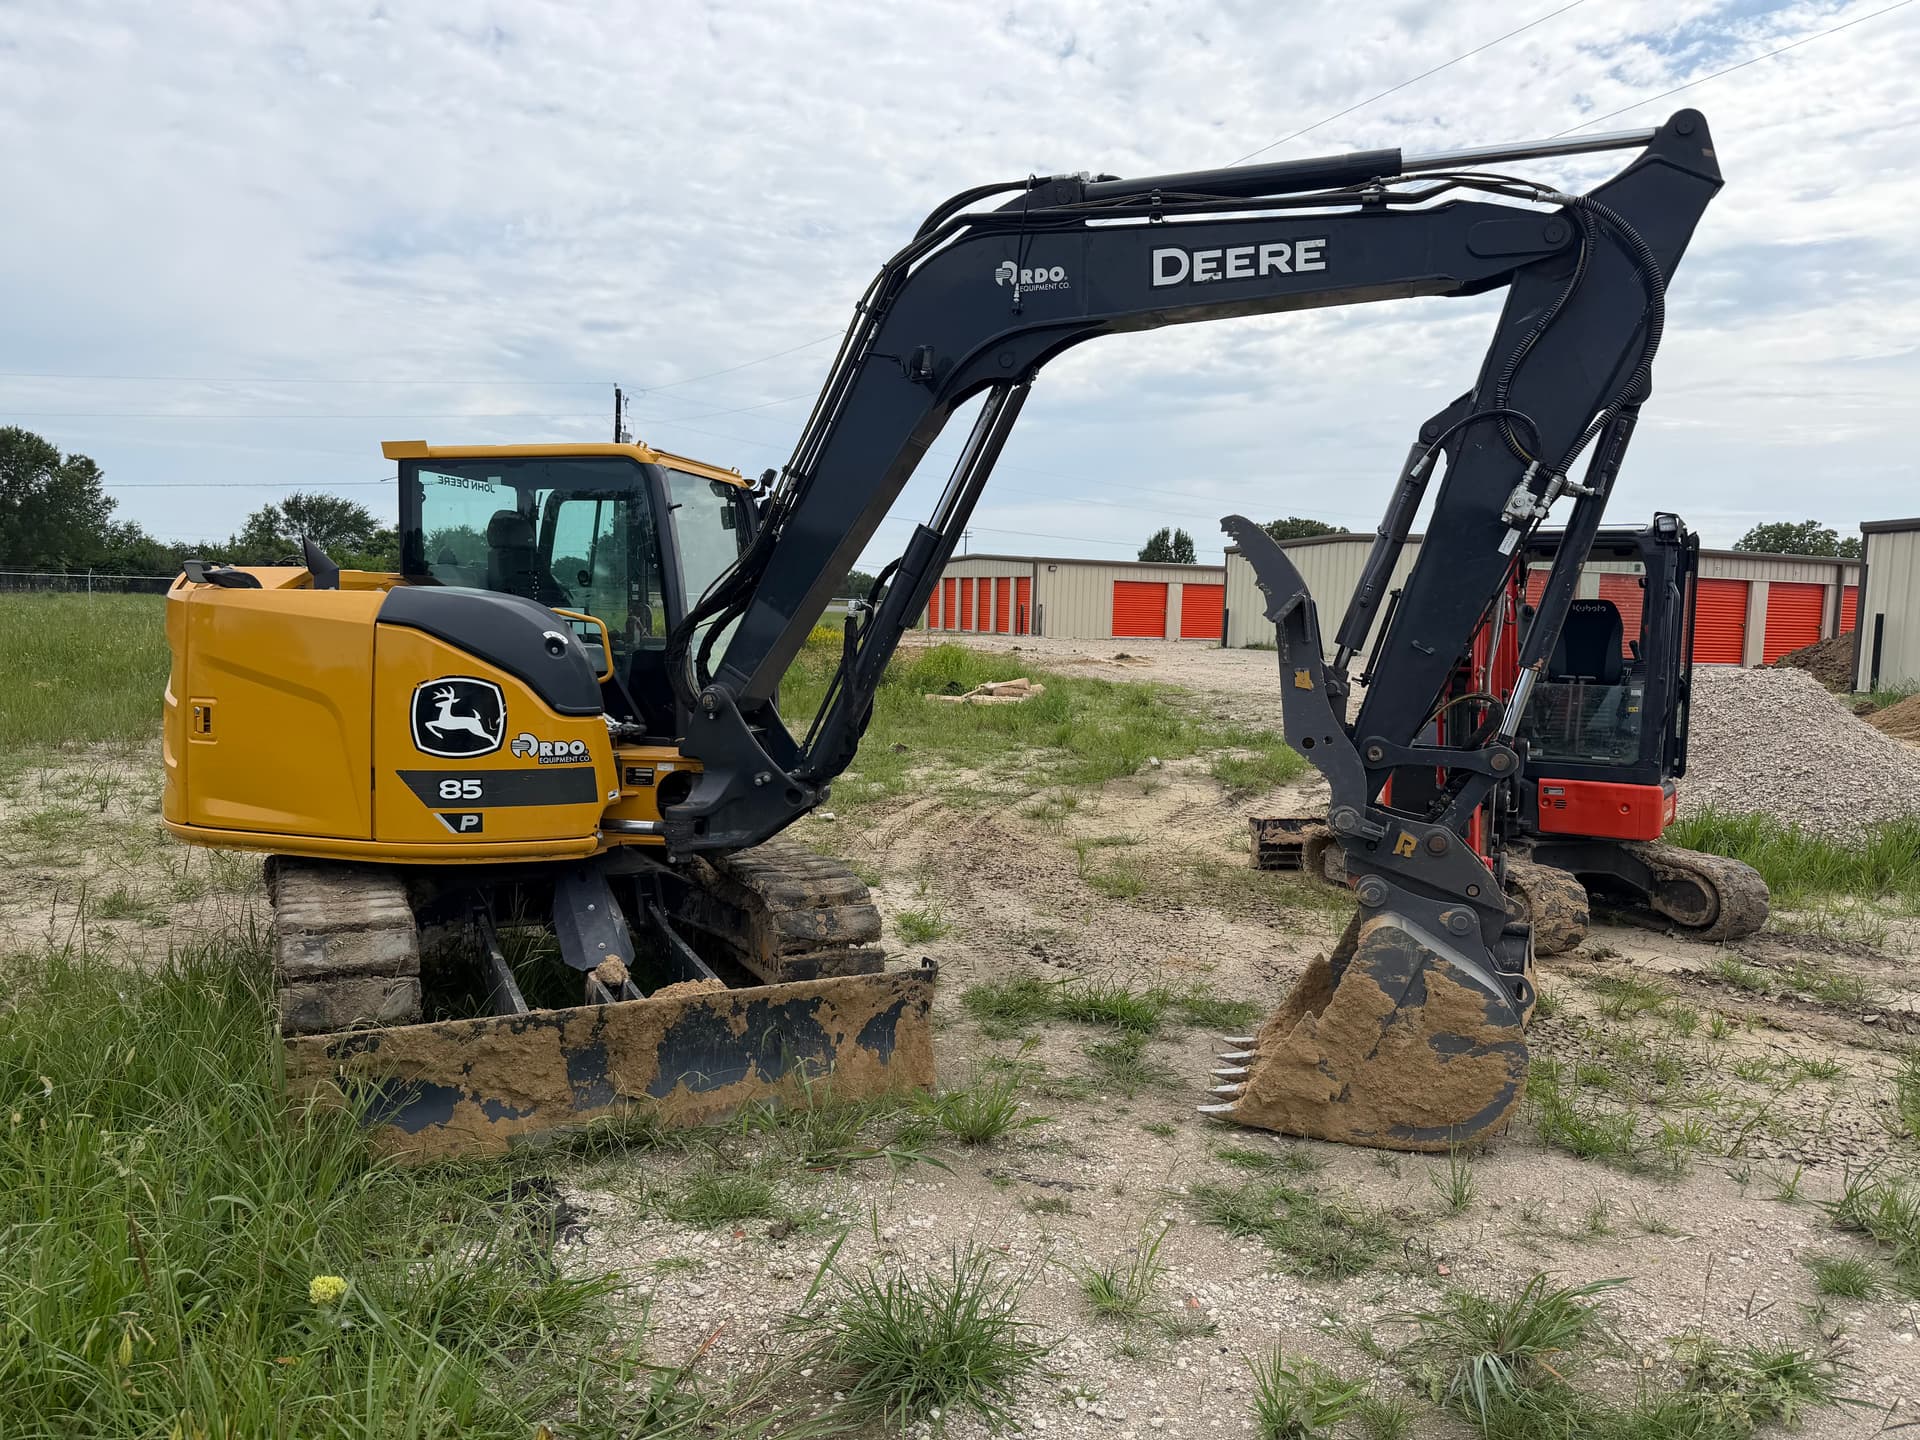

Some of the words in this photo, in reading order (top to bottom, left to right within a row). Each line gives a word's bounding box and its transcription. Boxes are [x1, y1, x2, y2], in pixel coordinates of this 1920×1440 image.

[1152, 239, 1327, 287] DEERE
[1019, 283, 1057, 293] EQUIPMENT
[1572, 604, 1607, 612] Kubota
[539, 755, 579, 764] EQUIPMENT
[439, 779, 483, 800] 85
[460, 814, 479, 832] P
